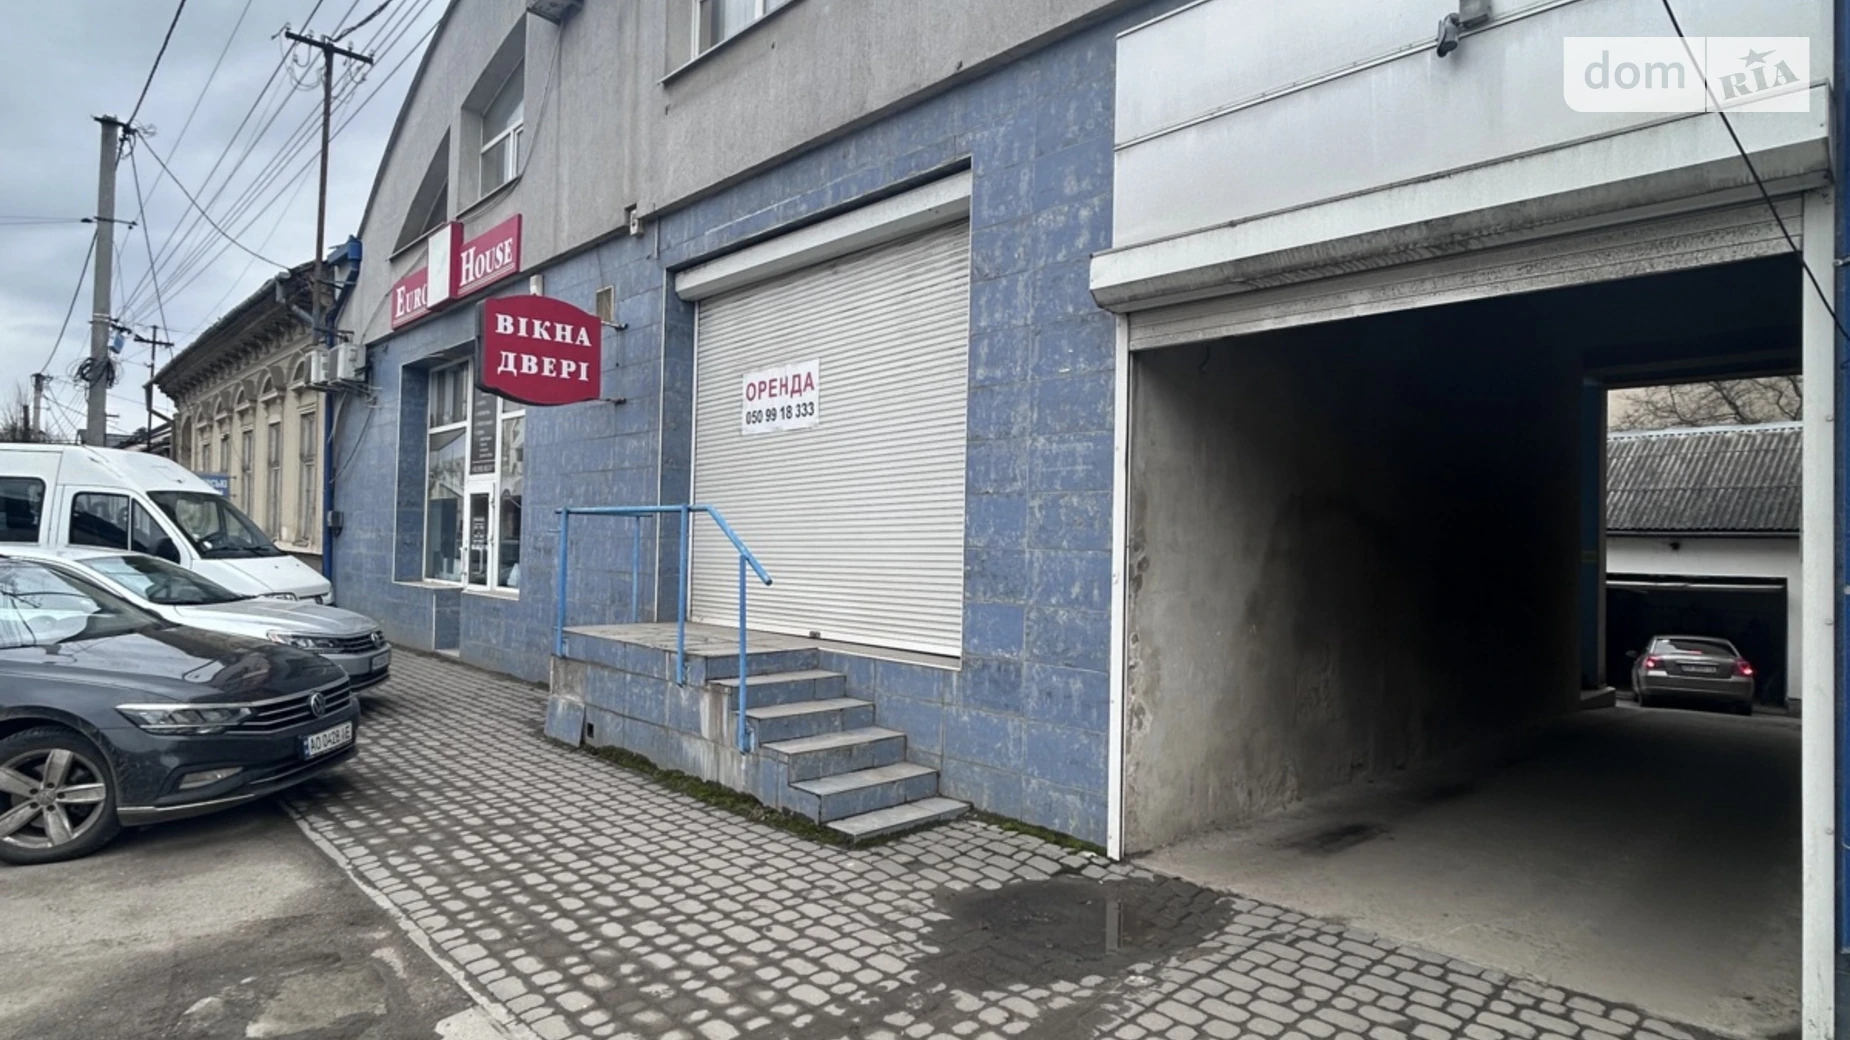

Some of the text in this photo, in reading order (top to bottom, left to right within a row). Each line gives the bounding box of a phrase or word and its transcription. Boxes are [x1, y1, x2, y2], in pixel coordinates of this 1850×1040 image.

[460, 238, 513, 286] HOUSE
[495, 313, 592, 347] ВІКНА
[497, 351, 589, 381] ДВЕРІ
[746, 372, 815, 401] ОРЕНДА
[746, 401, 815, 425] 050 99 18 333
